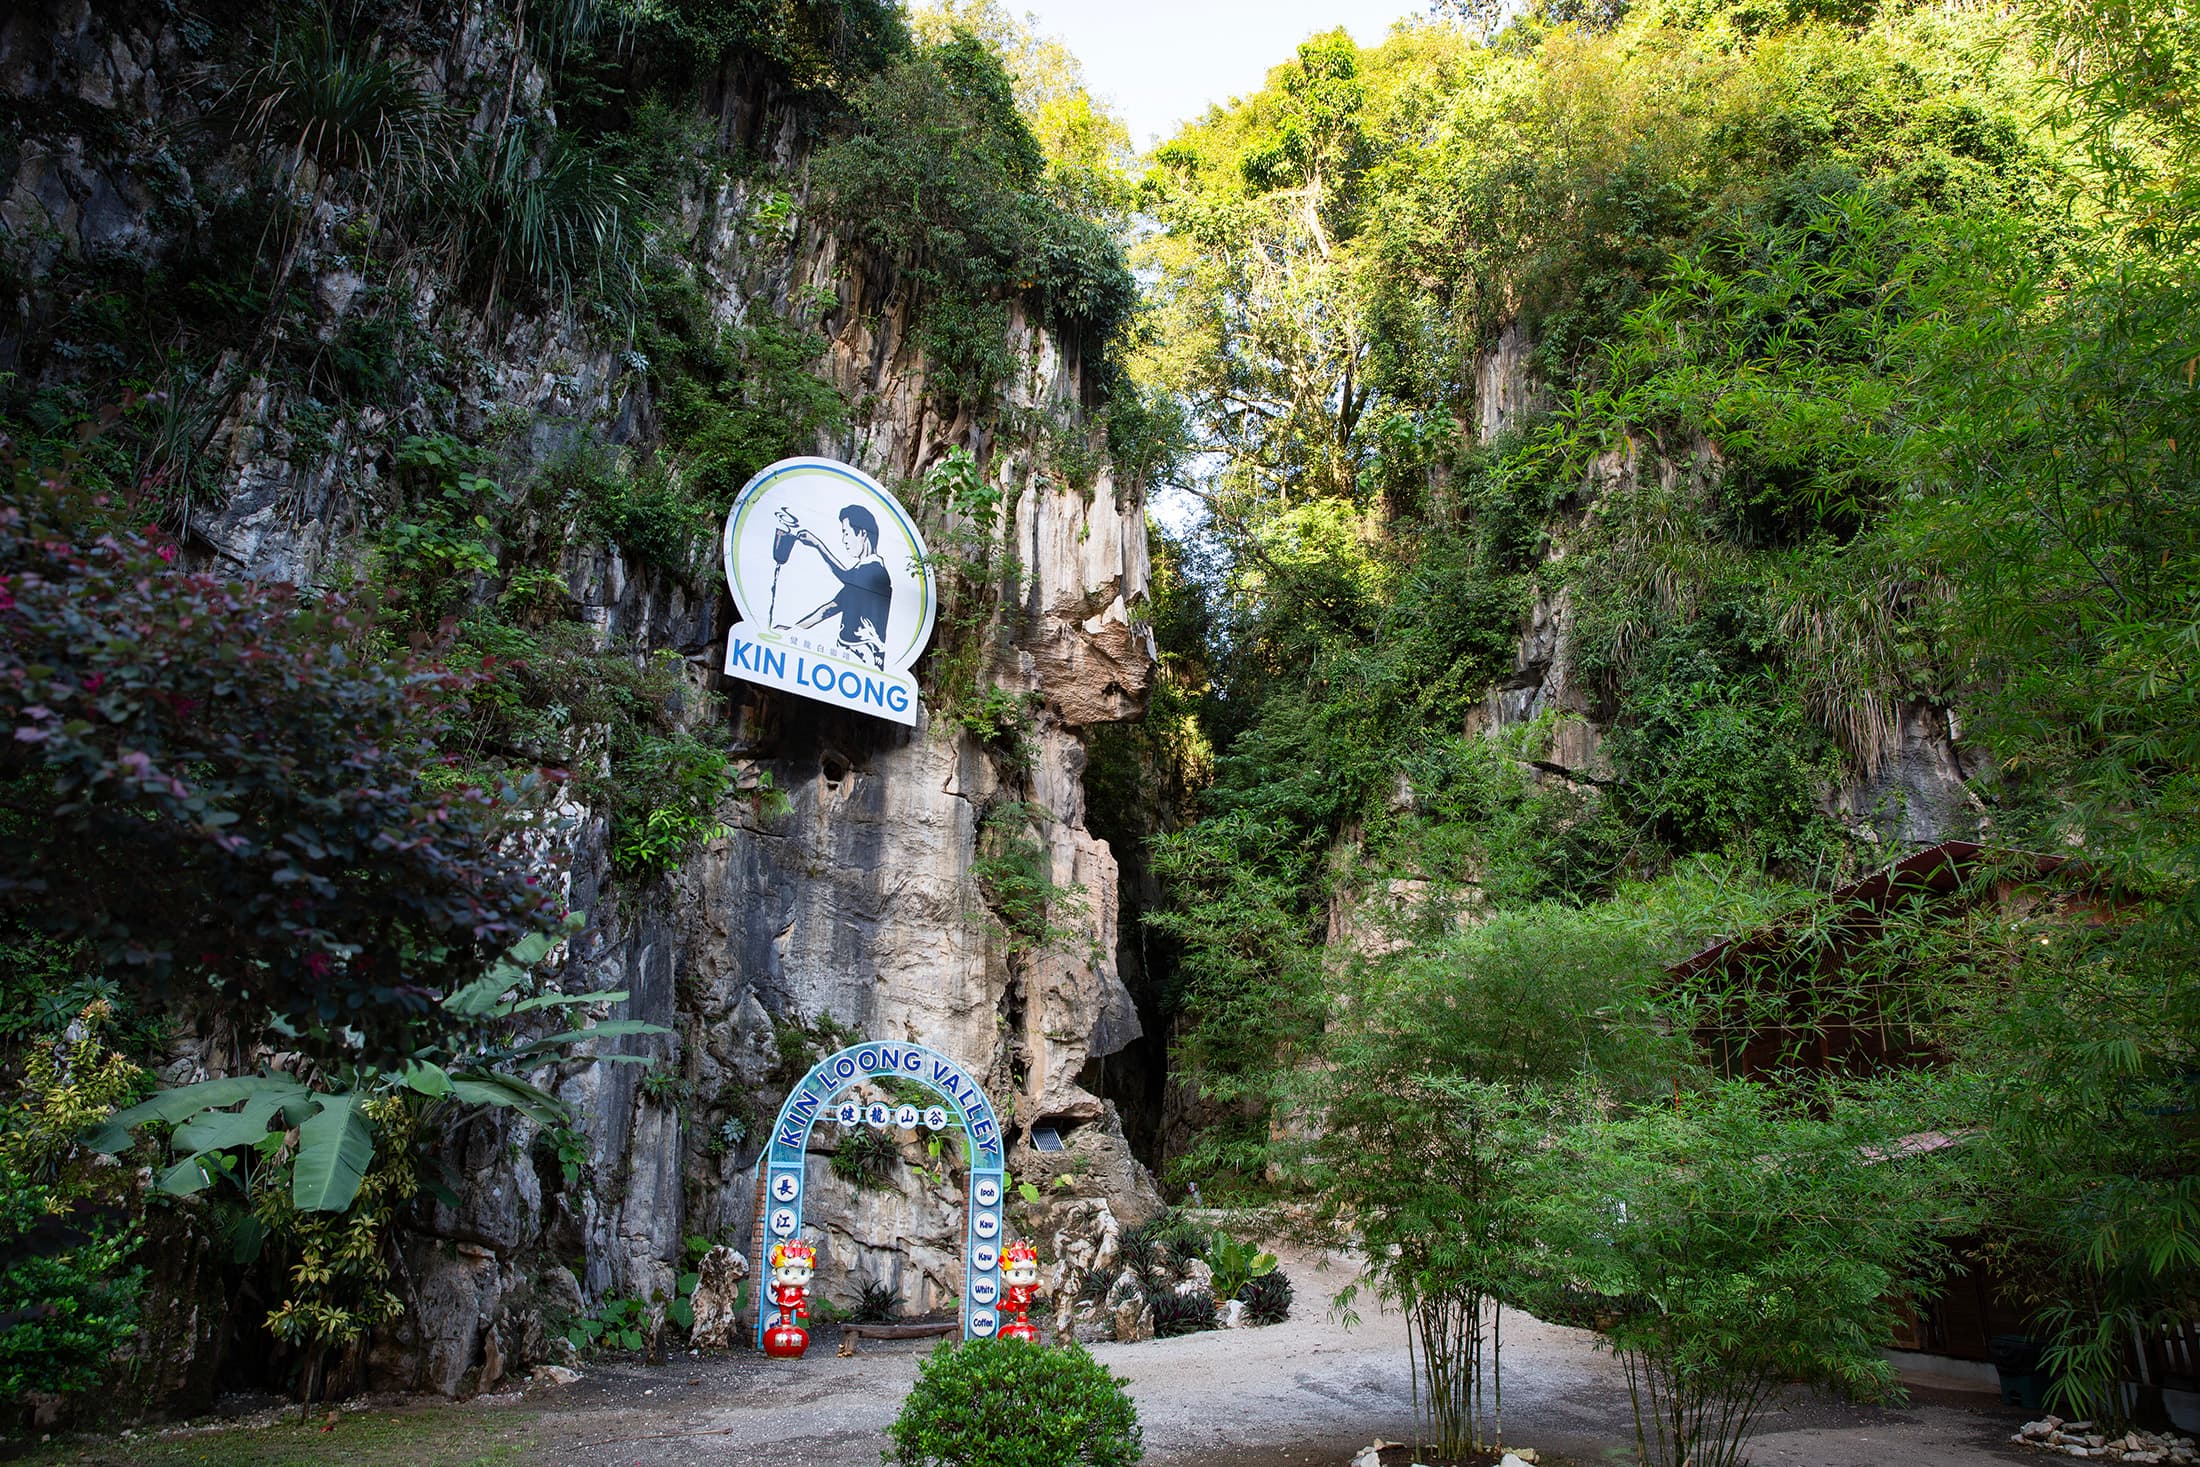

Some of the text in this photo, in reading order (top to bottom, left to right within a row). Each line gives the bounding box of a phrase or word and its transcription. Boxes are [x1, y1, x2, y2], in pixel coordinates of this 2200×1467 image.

[732, 638, 909, 713] KIN LOONG
[777, 1047, 998, 1155] KIN LOONG VALLEY
[841, 1105, 943, 1126] 健龍山谷
[980, 1188, 995, 1198] Ipoh
[979, 1220, 994, 1229] Kaw
[978, 1252, 993, 1261] Kaw
[975, 1285, 994, 1294] White
[973, 1318, 993, 1328] Coffee
